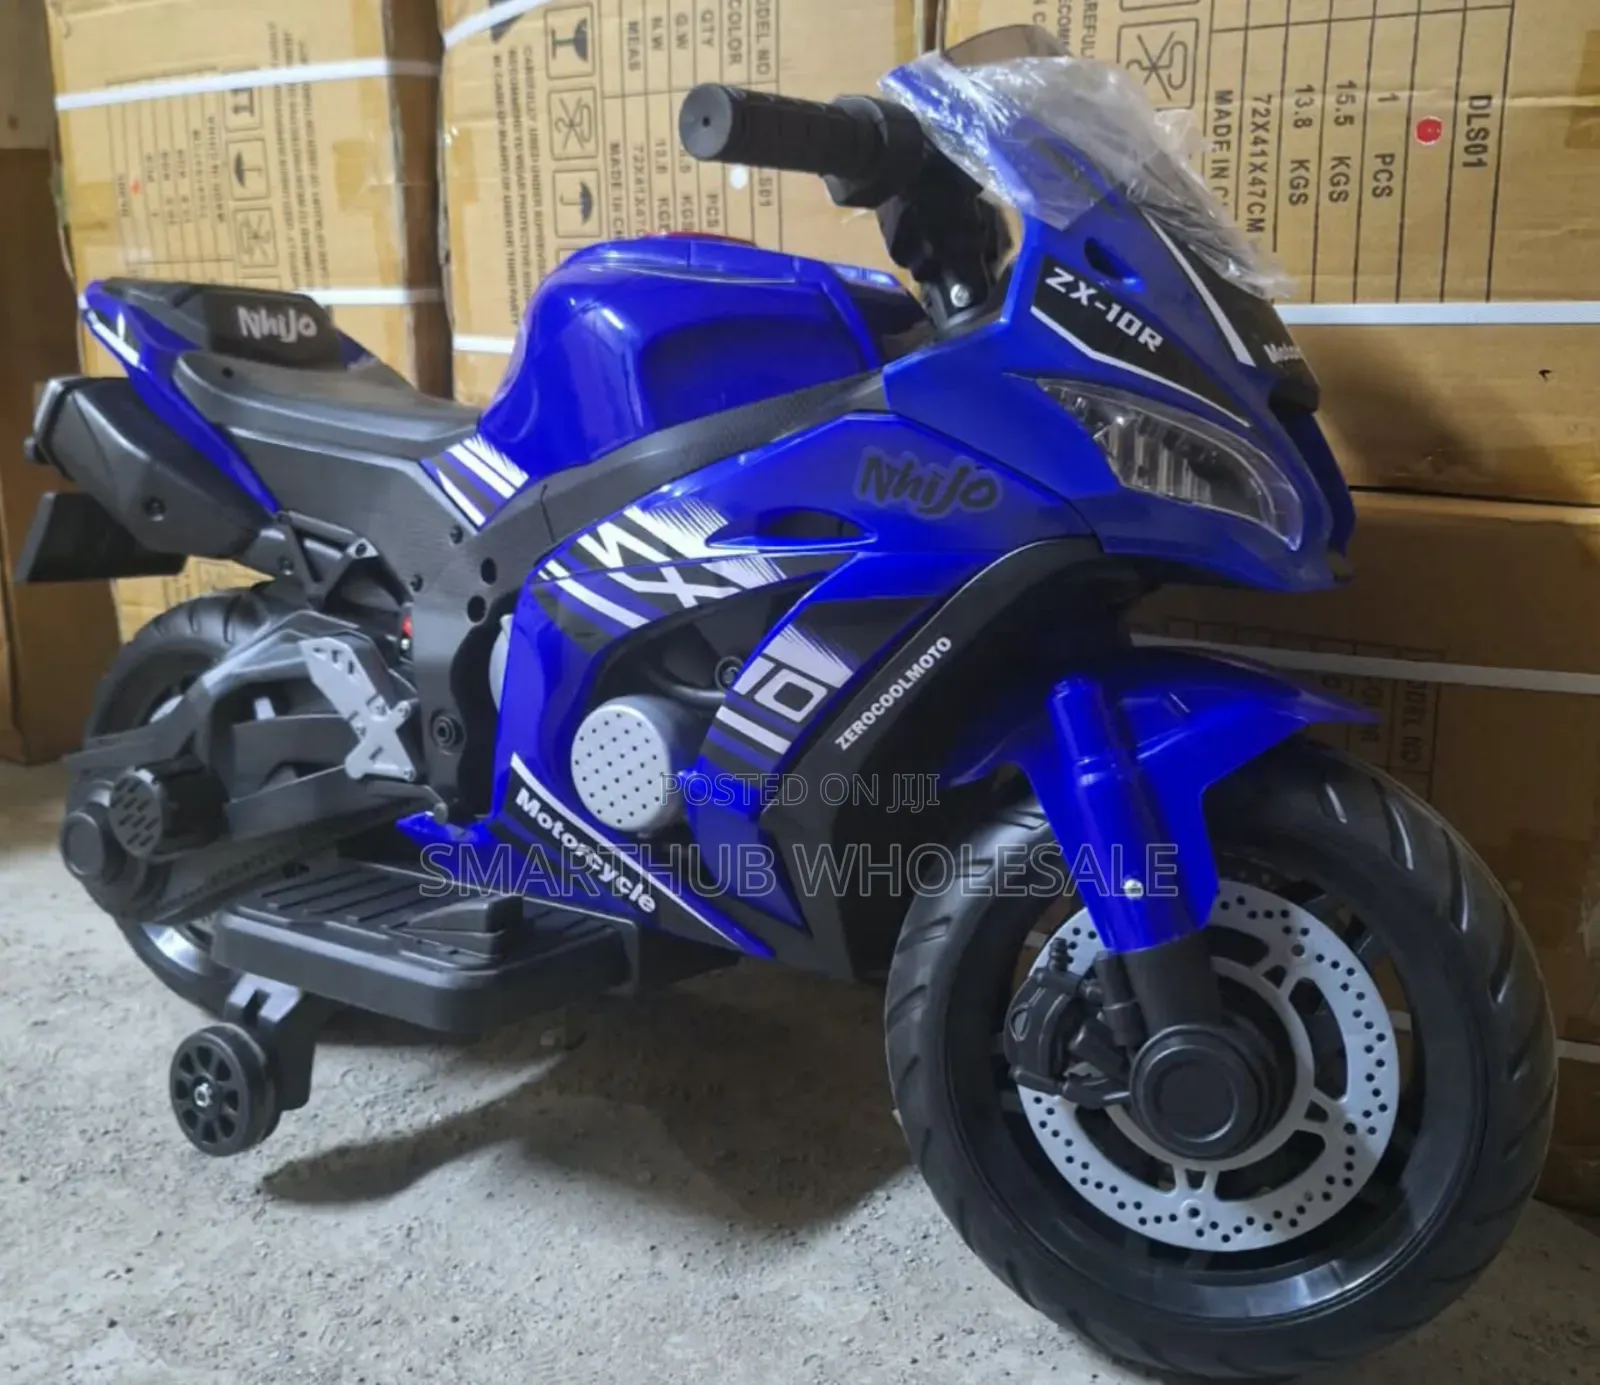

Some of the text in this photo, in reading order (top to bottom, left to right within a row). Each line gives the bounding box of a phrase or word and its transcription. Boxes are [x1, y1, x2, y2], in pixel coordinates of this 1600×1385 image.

[727, 0, 742, 67] COLOR
[1210, 159, 1230, 180] IN
[1212, 89, 1233, 153] MADE
[1245, 93, 1273, 234] 72X41X47CM
[1288, 83, 1316, 207] 13.8 KGS
[1328, 80, 1357, 204] 15.5 KGS
[1371, 92, 1398, 200] 1 PCS
[1461, 94, 1492, 169] DLS01
[1045, 266, 1164, 352] ZX-10R
[833, 635, 953, 751] ZEROCOOLMOTO
[515, 787, 656, 914] Motorcycle
